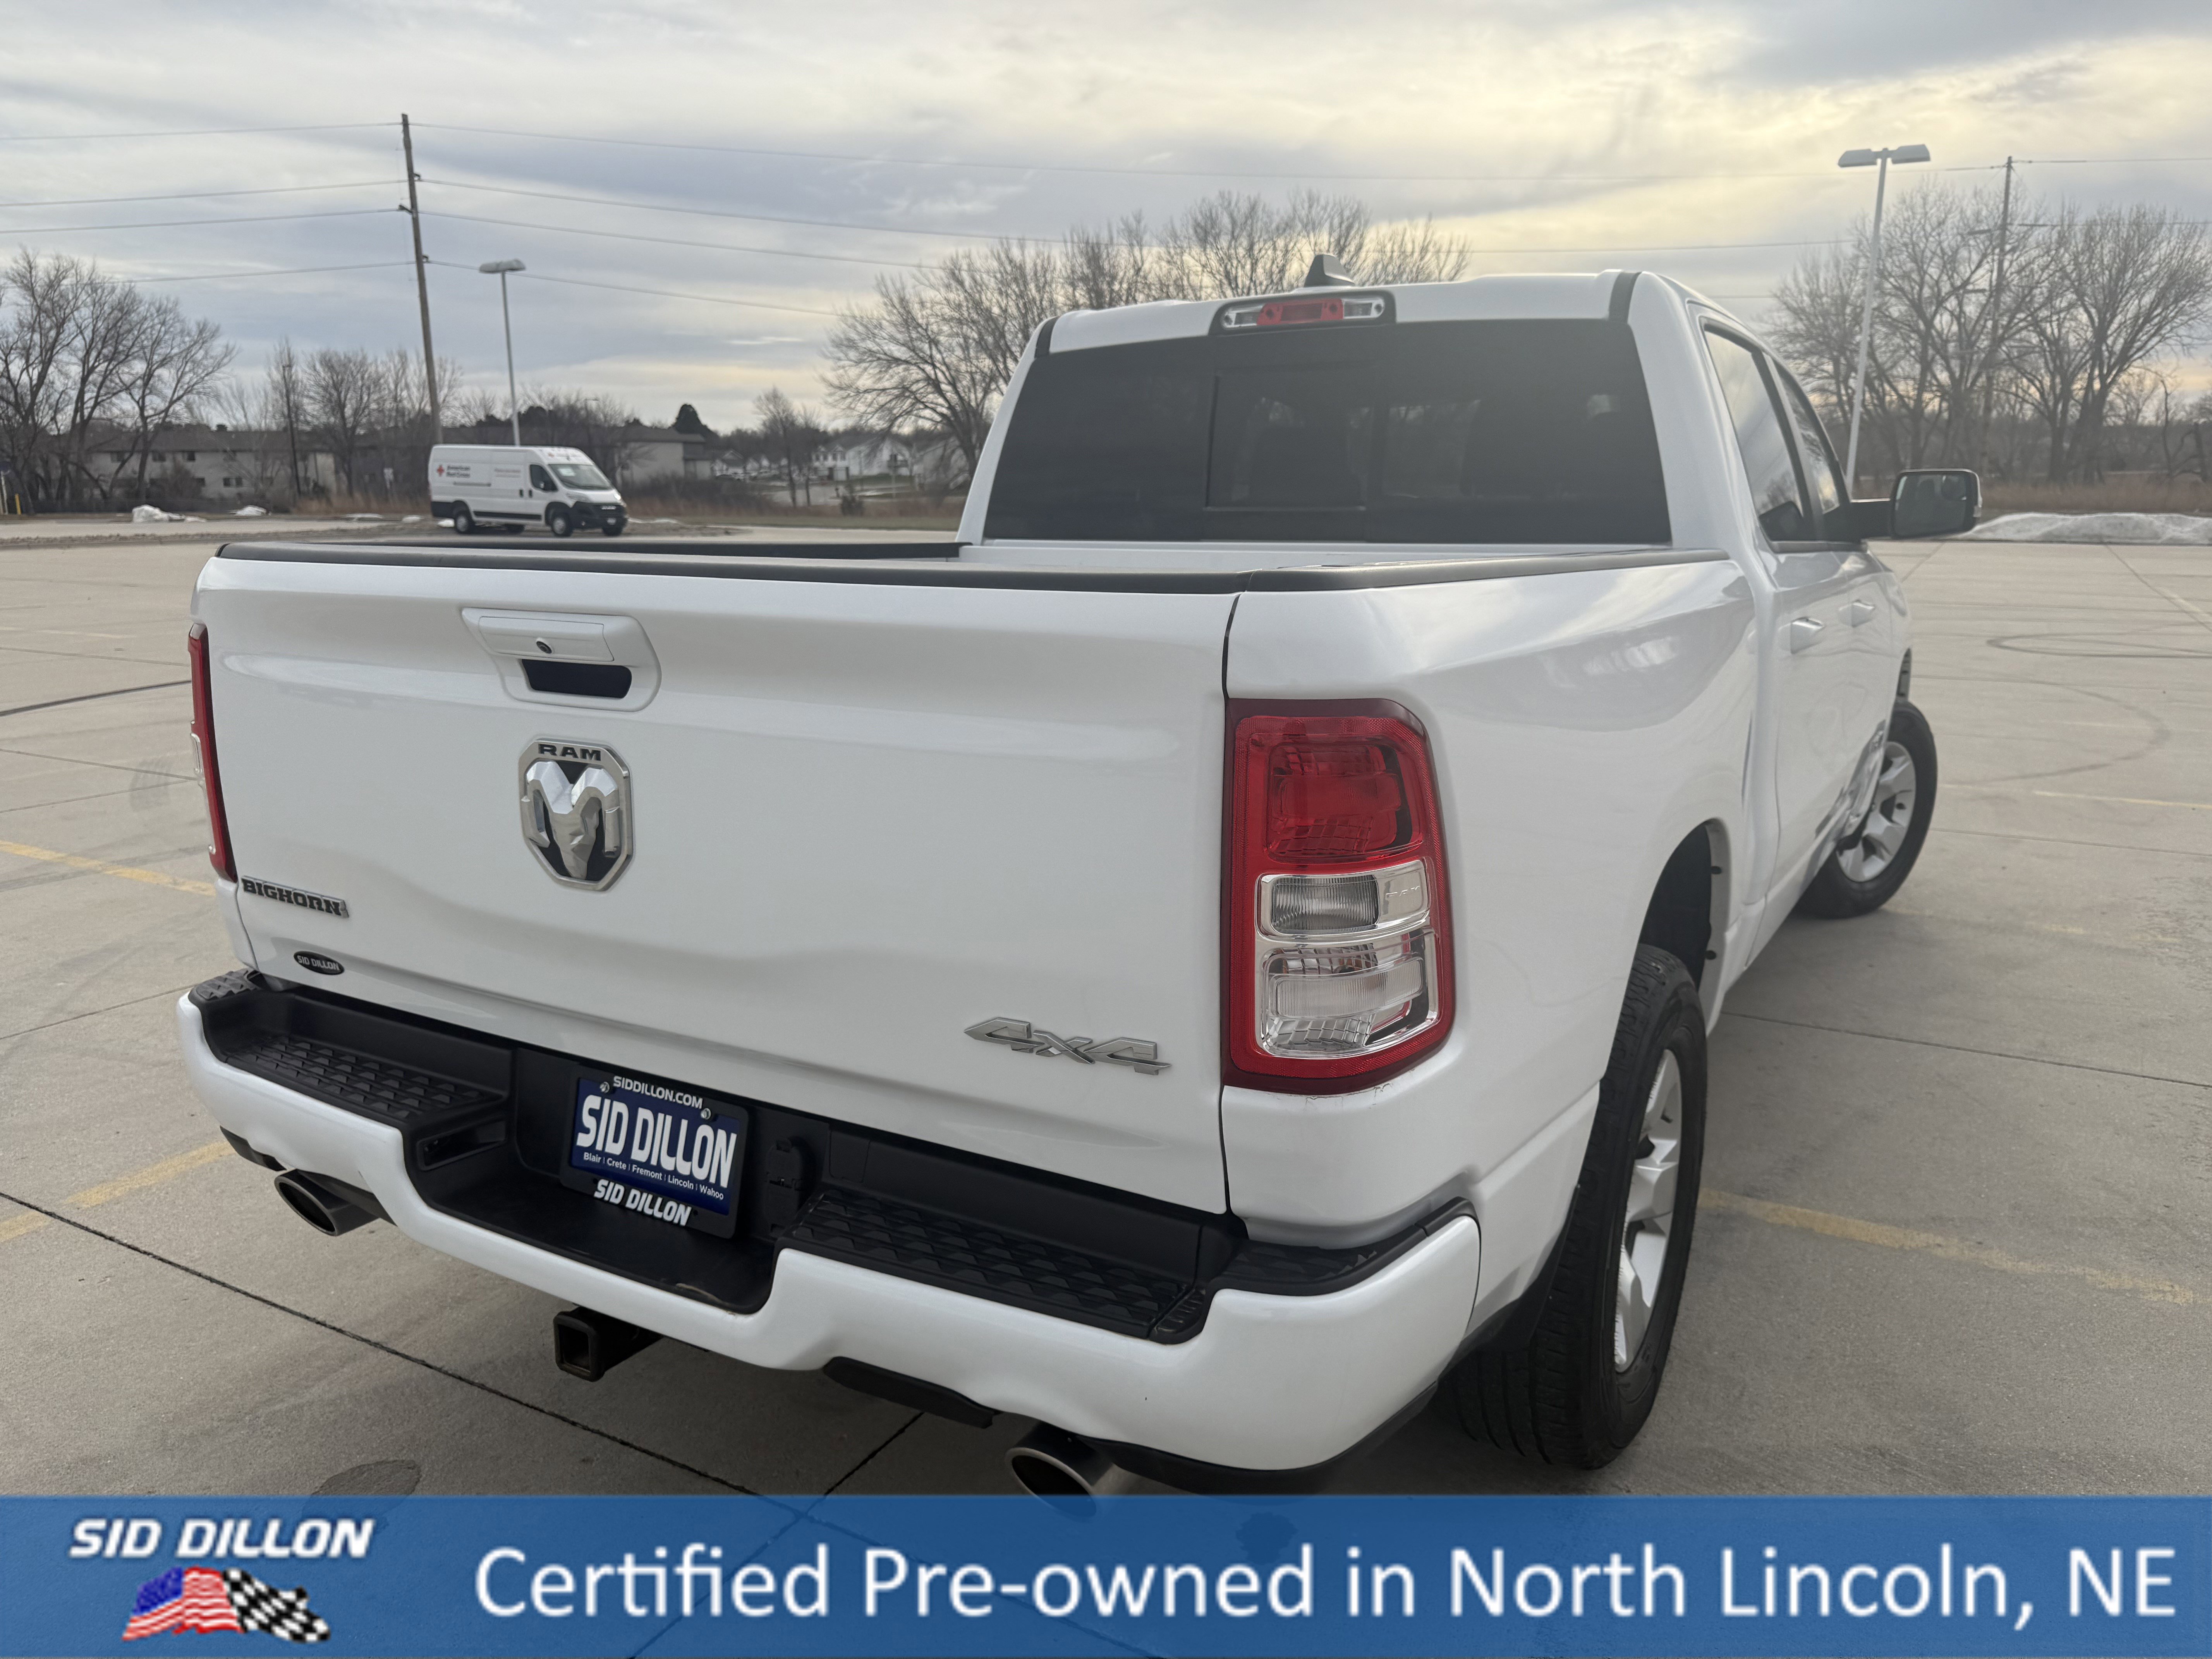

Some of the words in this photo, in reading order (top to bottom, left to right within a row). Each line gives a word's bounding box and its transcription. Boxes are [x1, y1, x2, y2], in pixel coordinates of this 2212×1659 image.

[538, 743, 601, 762] RAM
[241, 877, 345, 917] BIGHORN
[297, 955, 310, 965] SID
[311, 958, 340, 971] DILLON
[613, 1075, 703, 1109] SIDDILLON.COM
[576, 1094, 629, 1156] SID
[630, 1107, 737, 1188] DILLON
[583, 1152, 602, 1163] Blair
[606, 1158, 627, 1170] Crete
[632, 1164, 663, 1181] Fremont
[668, 1175, 694, 1190] Lincoln
[699, 1184, 724, 1200] Wahoo
[594, 1179, 625, 1205] SID
[625, 1188, 692, 1226] DILLON
